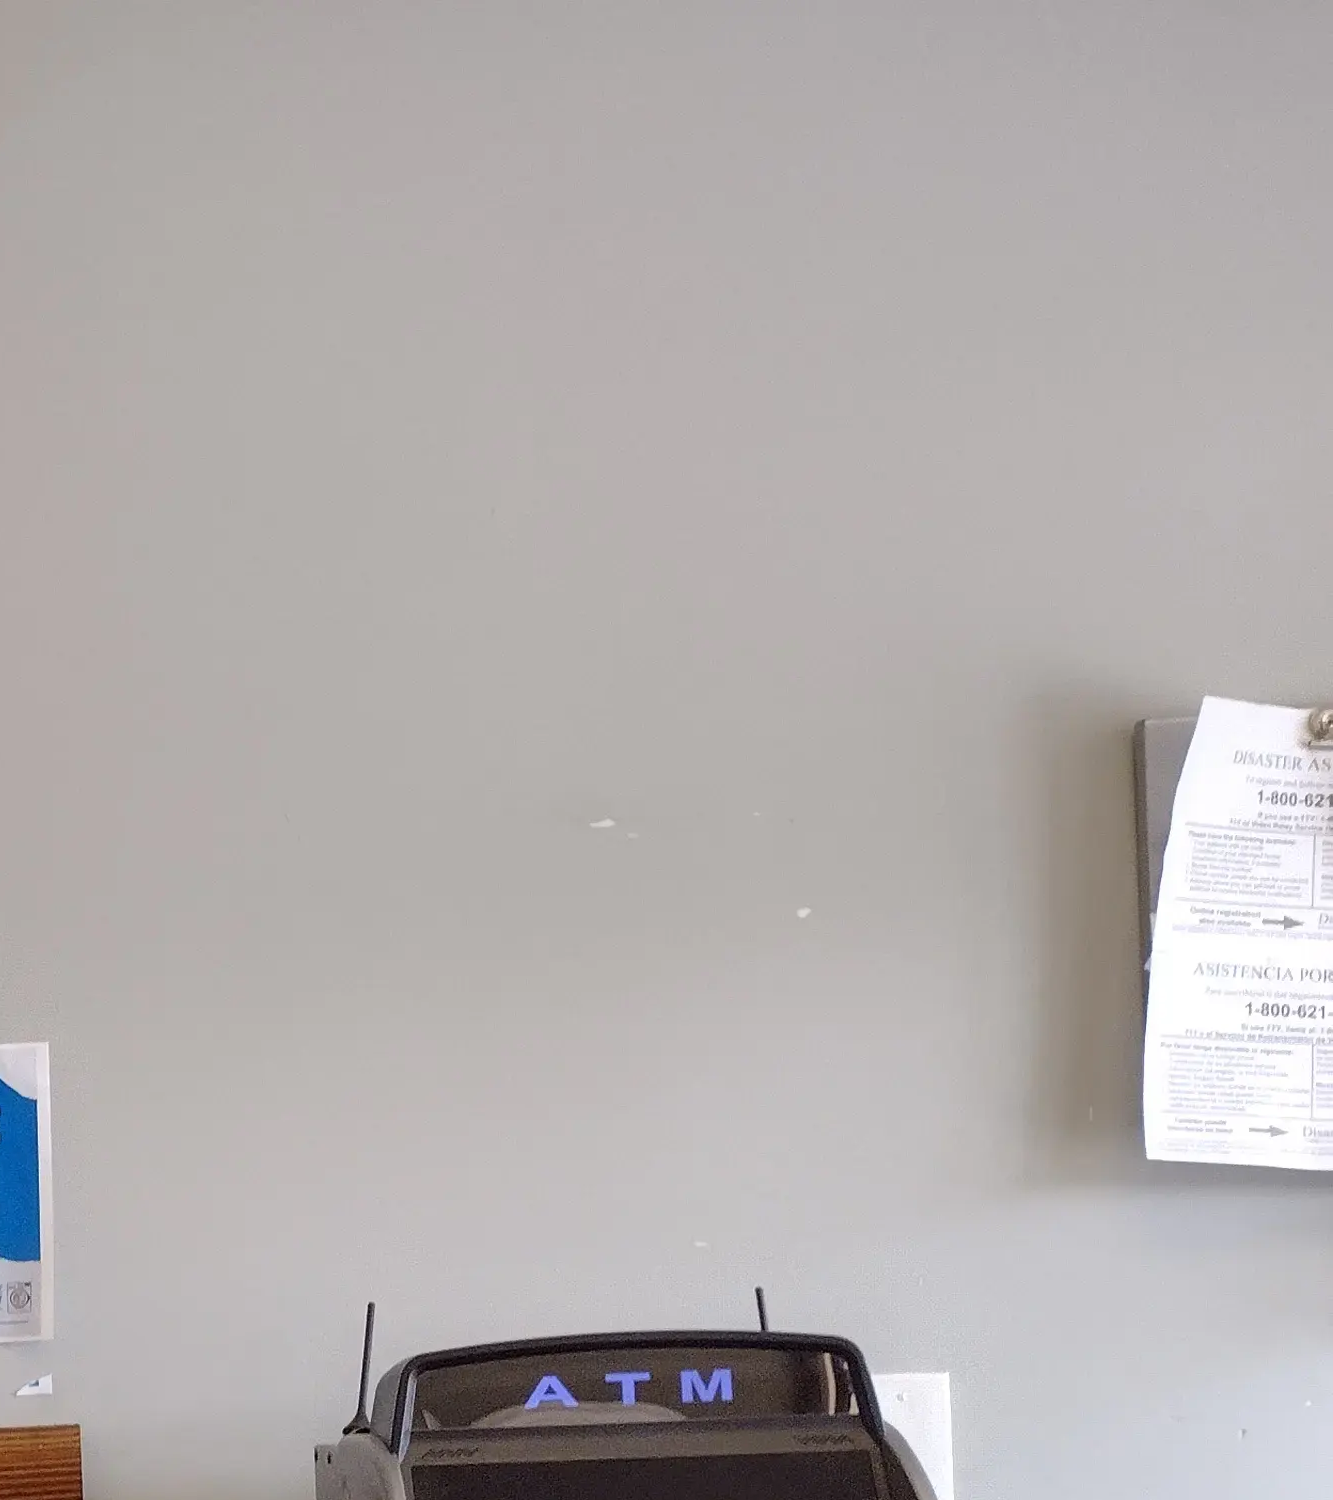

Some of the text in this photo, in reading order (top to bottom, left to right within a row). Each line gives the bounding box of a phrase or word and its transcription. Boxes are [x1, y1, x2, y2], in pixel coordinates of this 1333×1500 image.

[1233, 750, 1303, 771] DISASTER
[1193, 962, 1294, 982] ASISTENCIA
[523, 1368, 734, 1409] ATM
